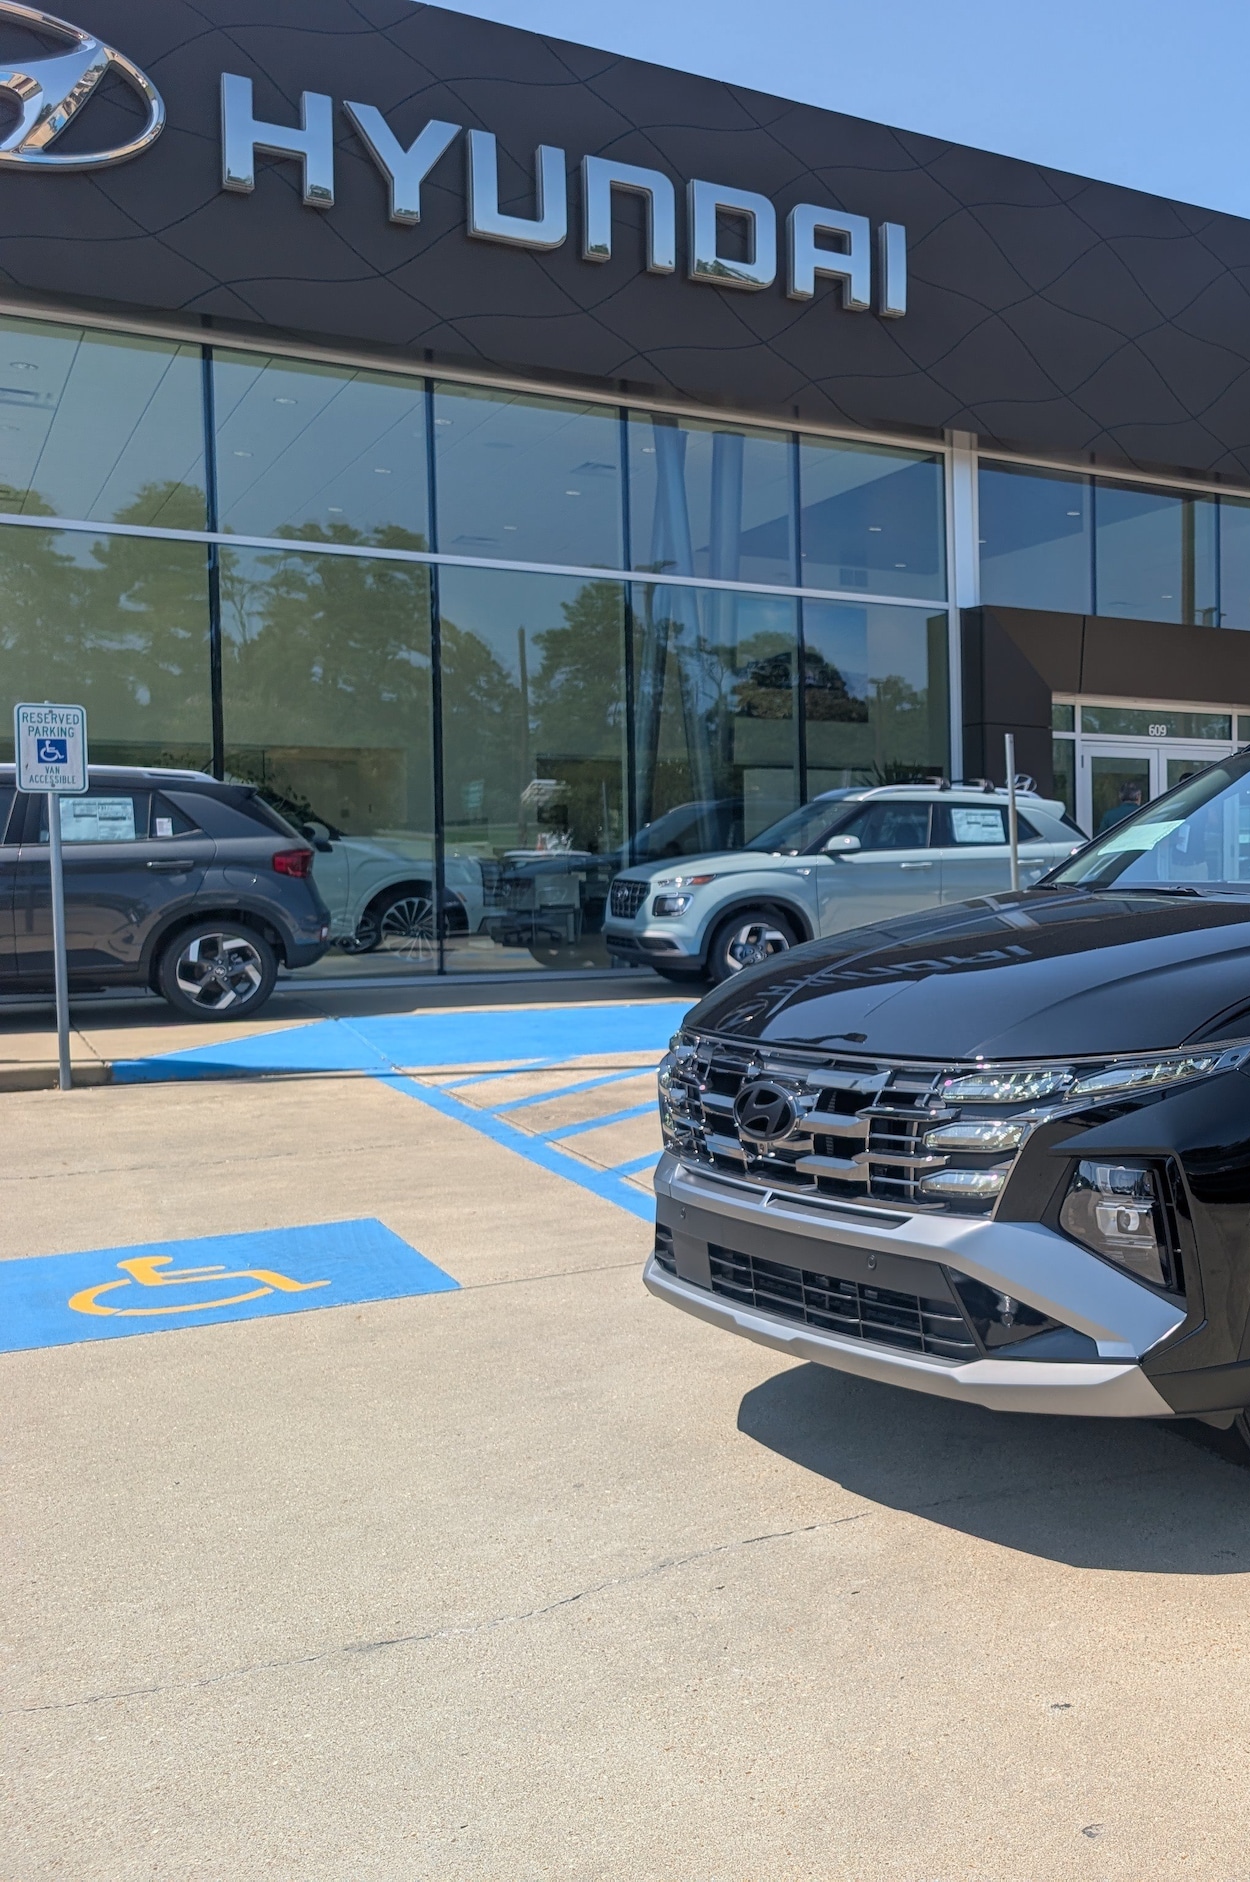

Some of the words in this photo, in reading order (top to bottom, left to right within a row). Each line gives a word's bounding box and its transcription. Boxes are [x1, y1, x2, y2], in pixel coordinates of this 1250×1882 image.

[221, 72, 908, 319] HYUNDAI
[22, 712, 80, 725] RESERVED
[28, 725, 75, 738] PARKING
[1149, 725, 1167, 737] 609
[45, 766, 60, 775] VAN
[29, 775, 76, 785] ACCESSIBLE
